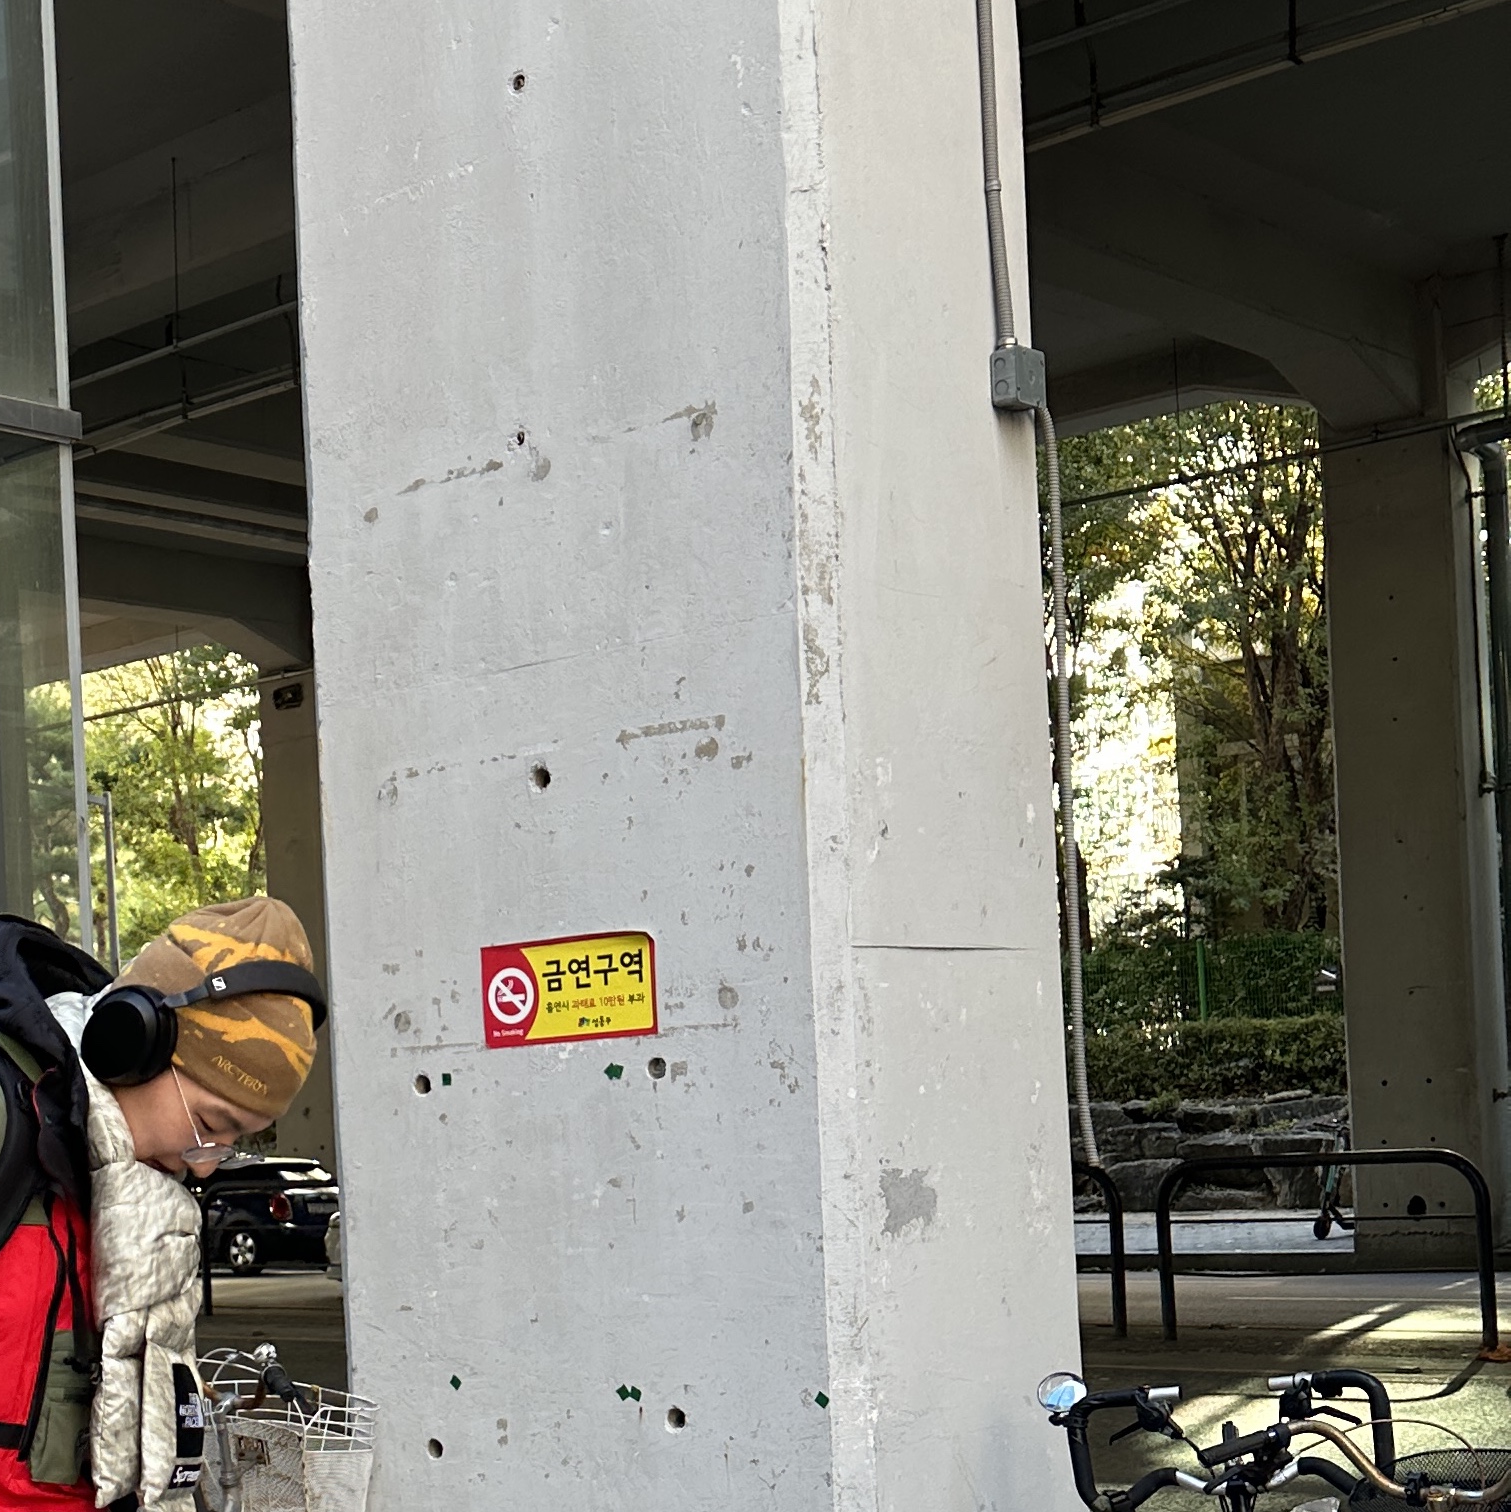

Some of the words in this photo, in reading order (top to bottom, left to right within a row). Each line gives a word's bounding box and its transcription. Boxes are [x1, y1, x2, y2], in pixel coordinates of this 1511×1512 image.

[542, 948, 644, 992] 금연구역
[546, 1000, 570, 1013] 흡연시
[599, 994, 625, 1008] 10만원
